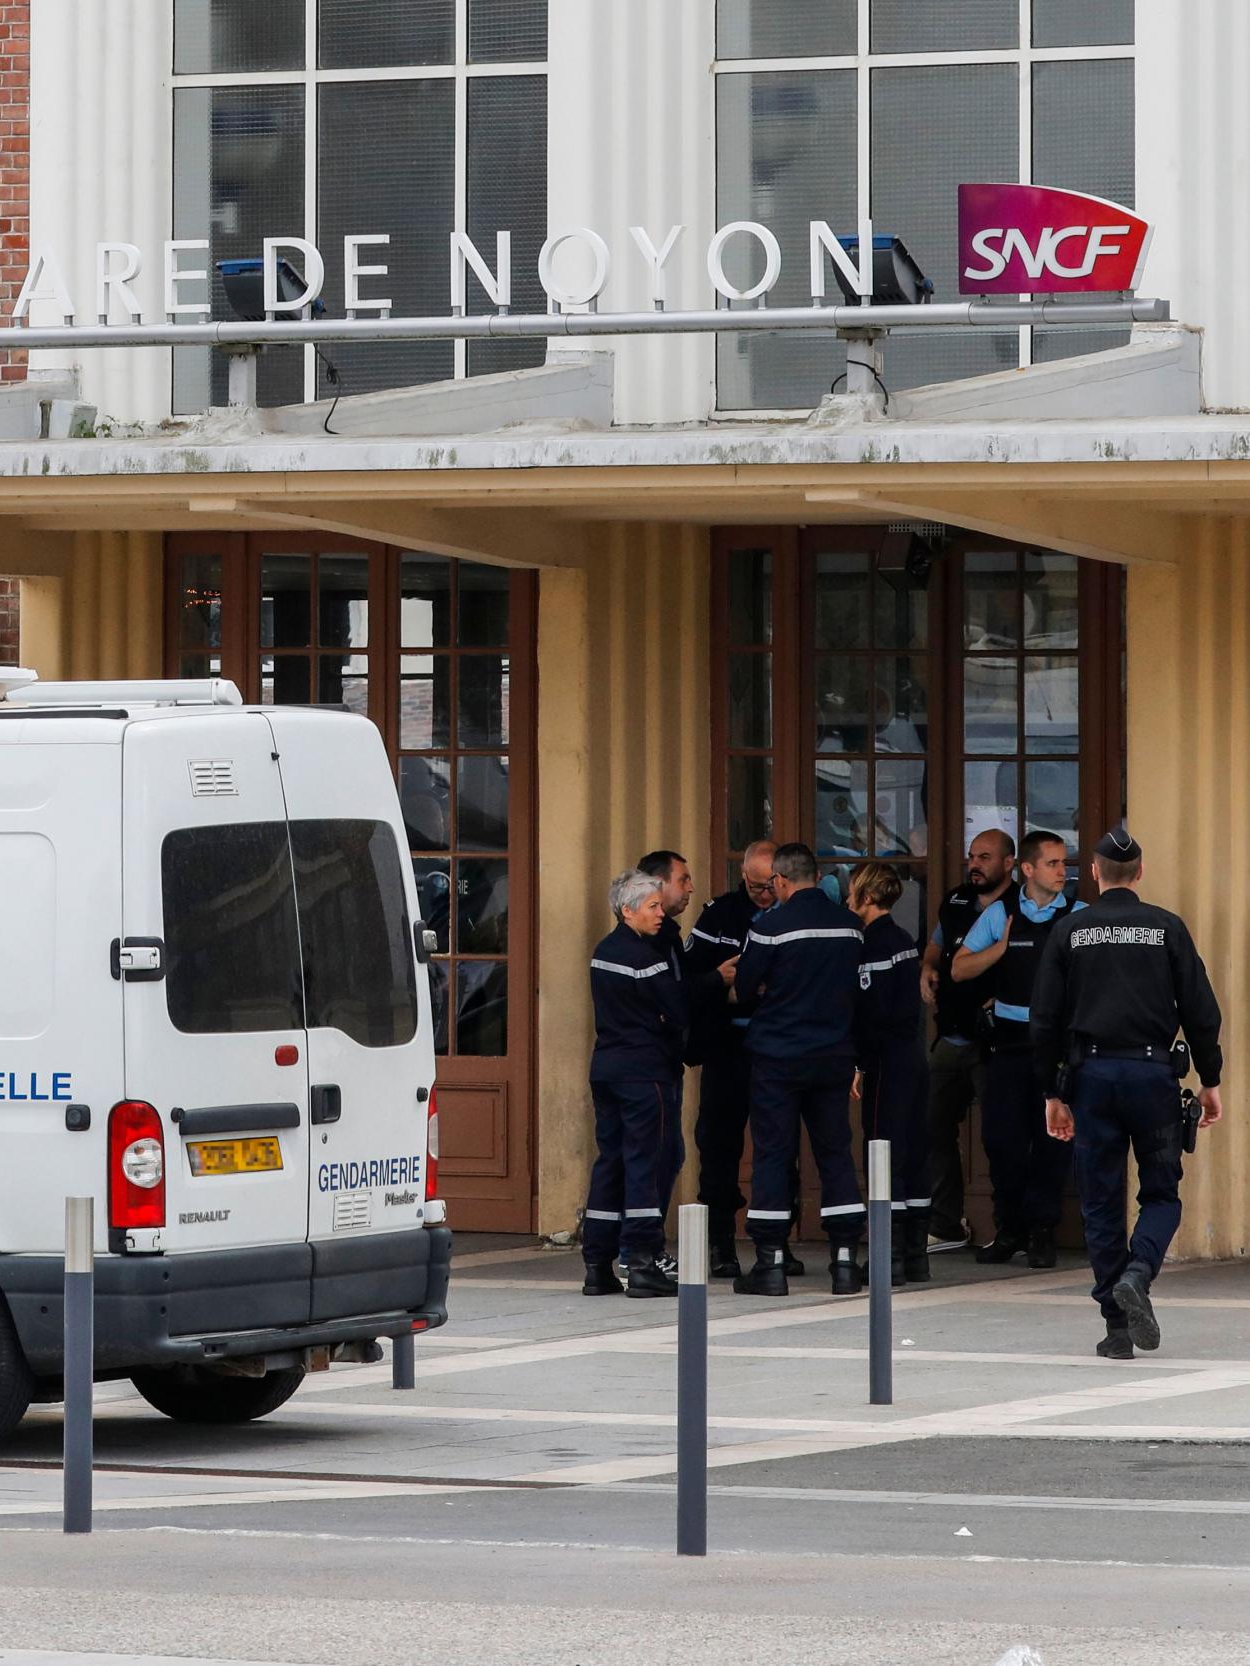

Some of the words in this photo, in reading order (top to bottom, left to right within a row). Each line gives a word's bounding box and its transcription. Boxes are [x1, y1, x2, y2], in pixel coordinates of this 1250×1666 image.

[263, 234, 393, 312] DE
[450, 219, 873, 307] NOYON
[964, 224, 1129, 281] SNCF
[1070, 926, 1165, 949] GENDARMERIE
[317, 1156, 421, 1193] GENDARMERIE
[178, 1209, 231, 1225] RENAULT
